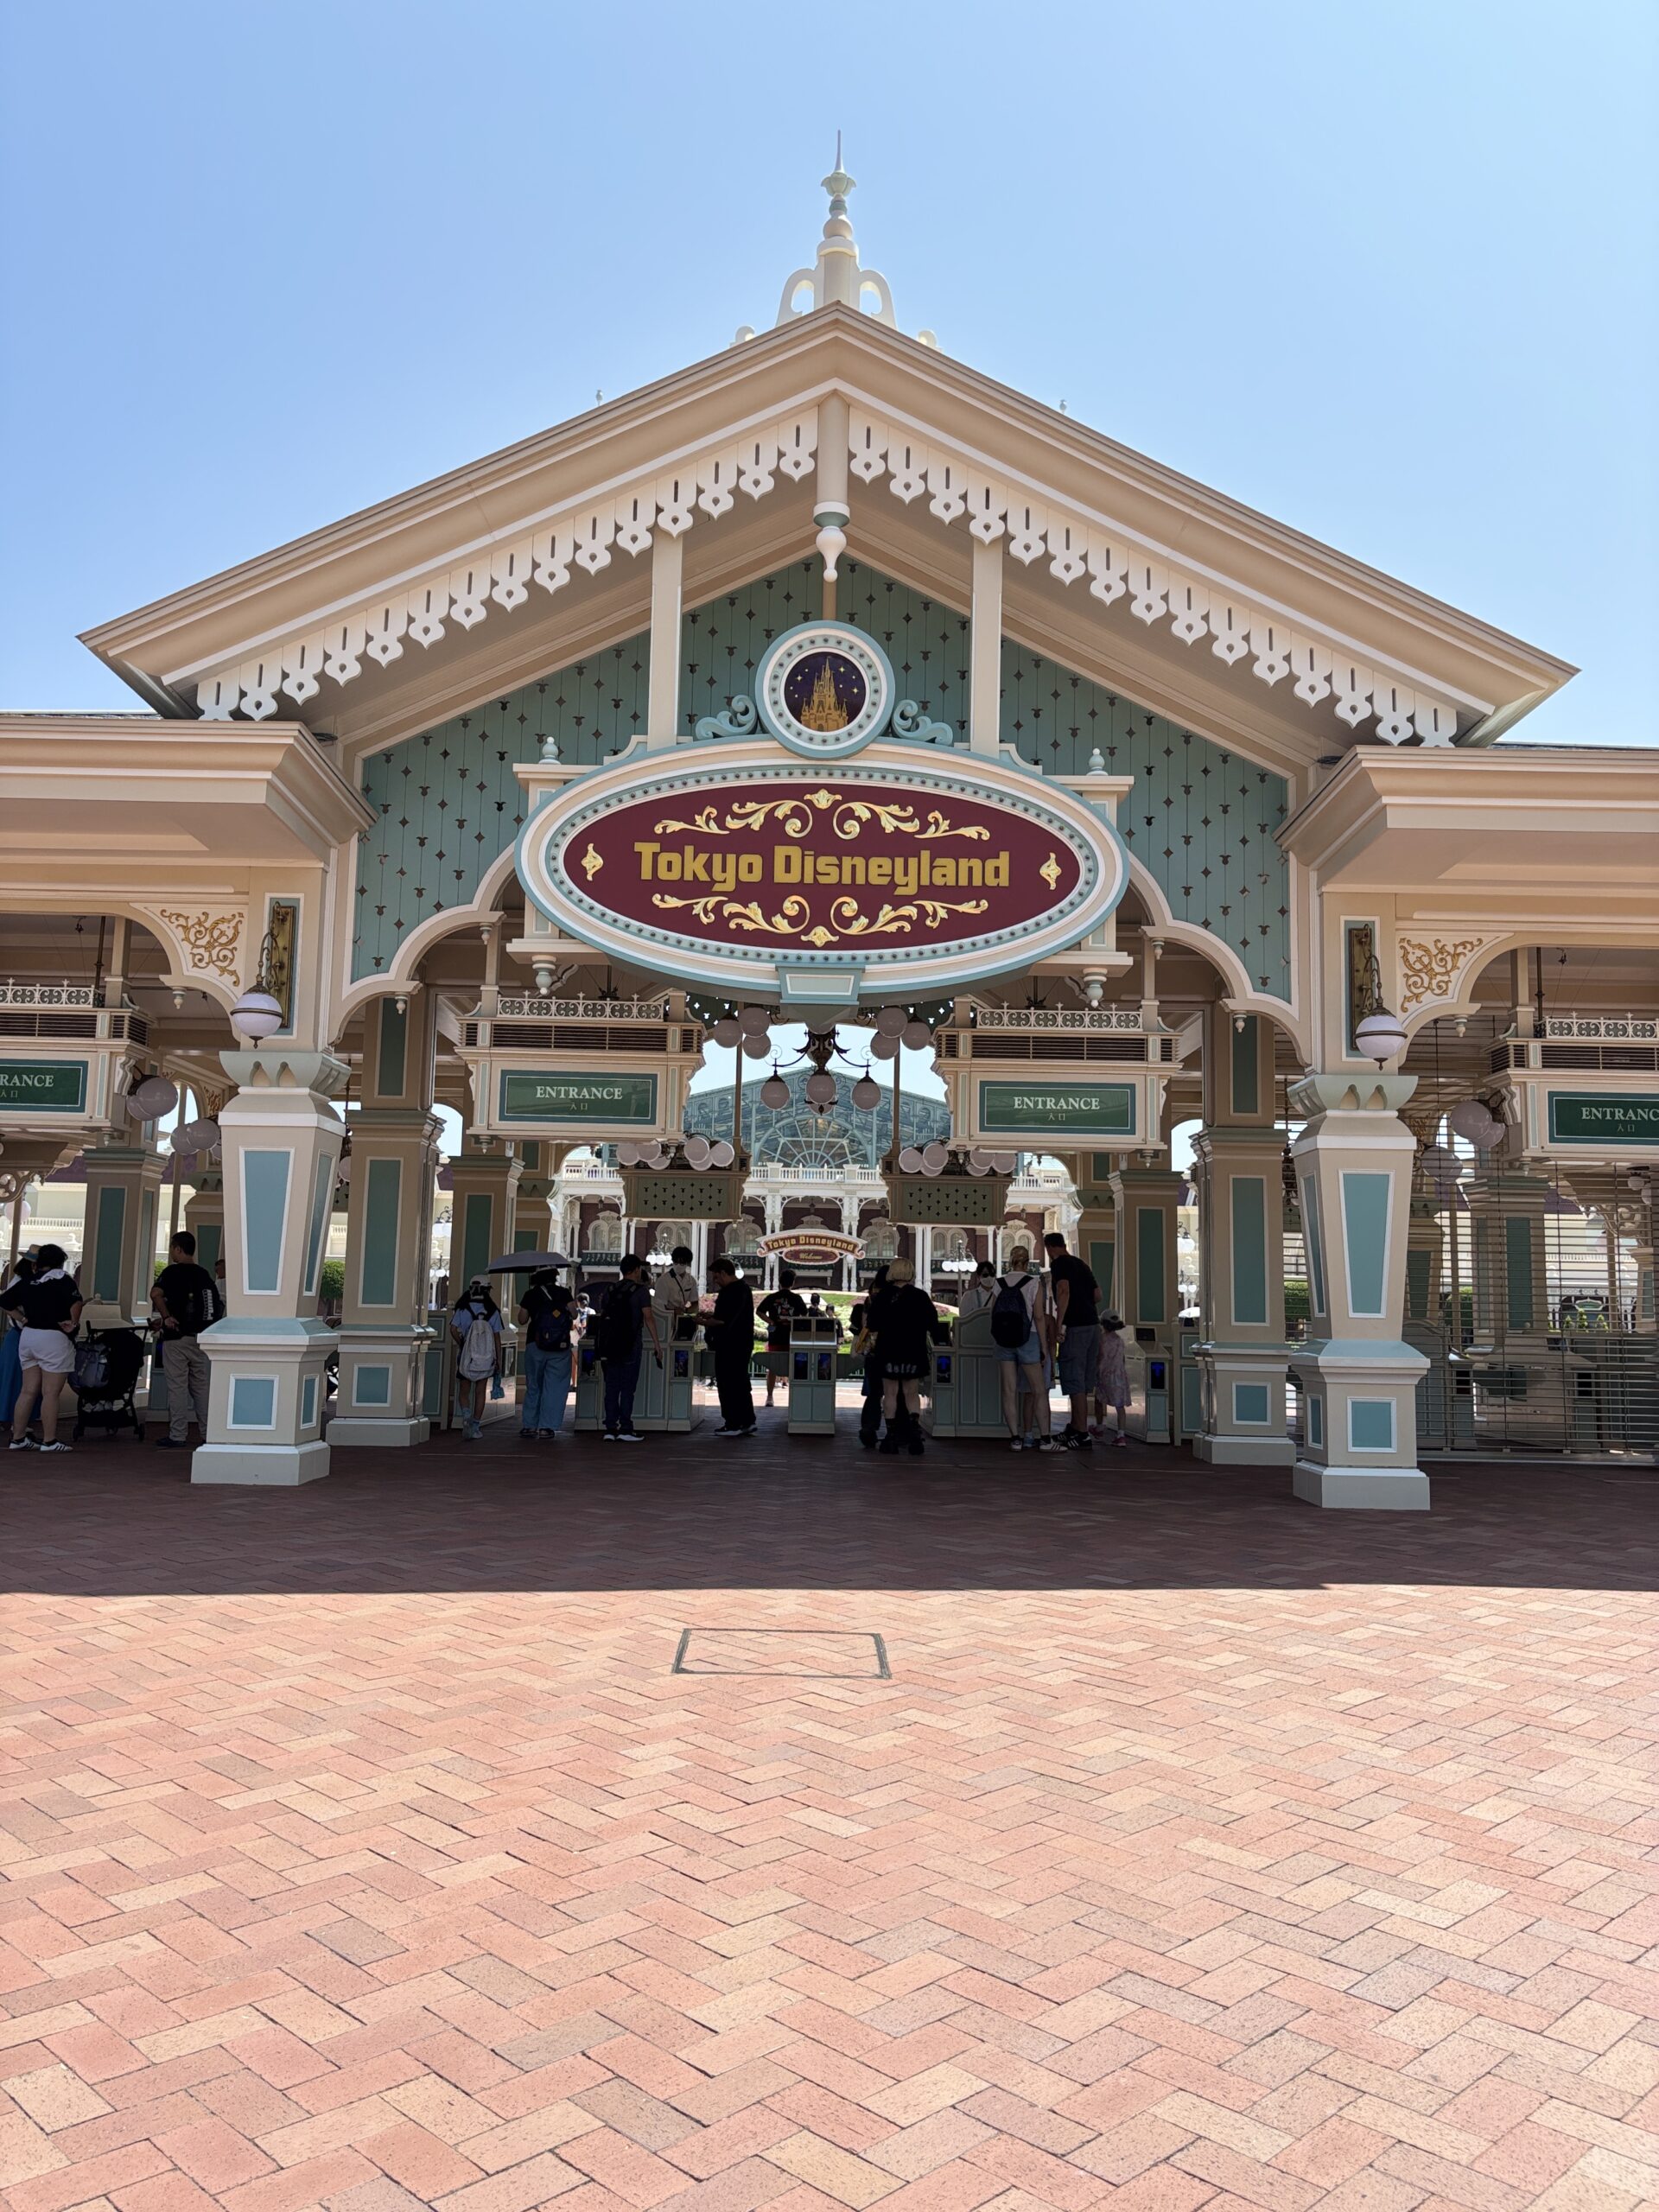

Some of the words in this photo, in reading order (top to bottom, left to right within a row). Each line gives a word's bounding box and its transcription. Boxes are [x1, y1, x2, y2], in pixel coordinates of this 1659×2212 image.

[634, 842, 762, 892] Tokyo
[774, 845, 1009, 895] Disneyland
[536, 1085, 623, 1099] ENTRANCE
[570, 1102, 588, 1110] 入口
[1014, 1096, 1100, 1109] ENTRANCE
[1048, 1112, 1065, 1121] 入口
[767, 1237, 797, 1250] Tokyo
[799, 1236, 855, 1251] Disneyland
